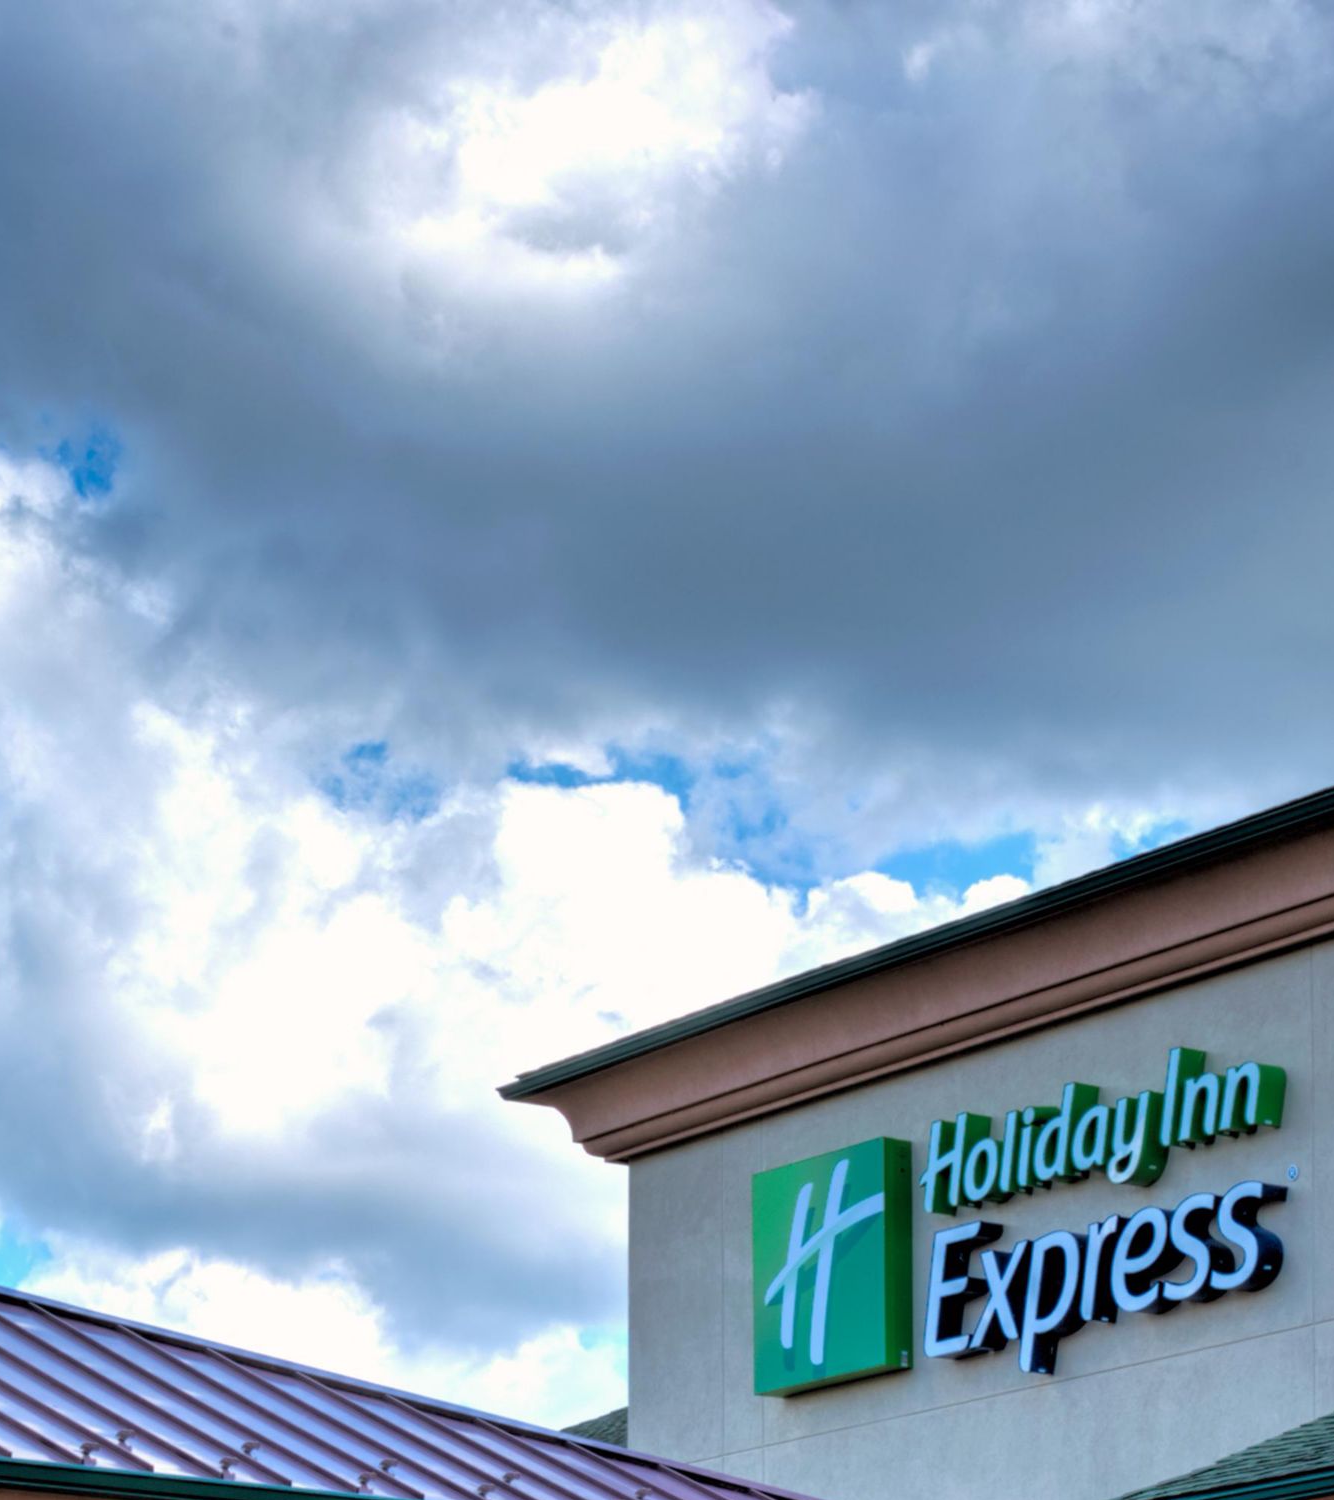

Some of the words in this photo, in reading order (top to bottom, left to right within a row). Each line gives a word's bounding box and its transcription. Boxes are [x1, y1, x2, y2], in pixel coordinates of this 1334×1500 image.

[920, 1082, 1167, 1213] Holiday
[1160, 1047, 1286, 1148] Inn
[765, 1158, 884, 1364] H
[924, 1180, 1287, 1374] Express
